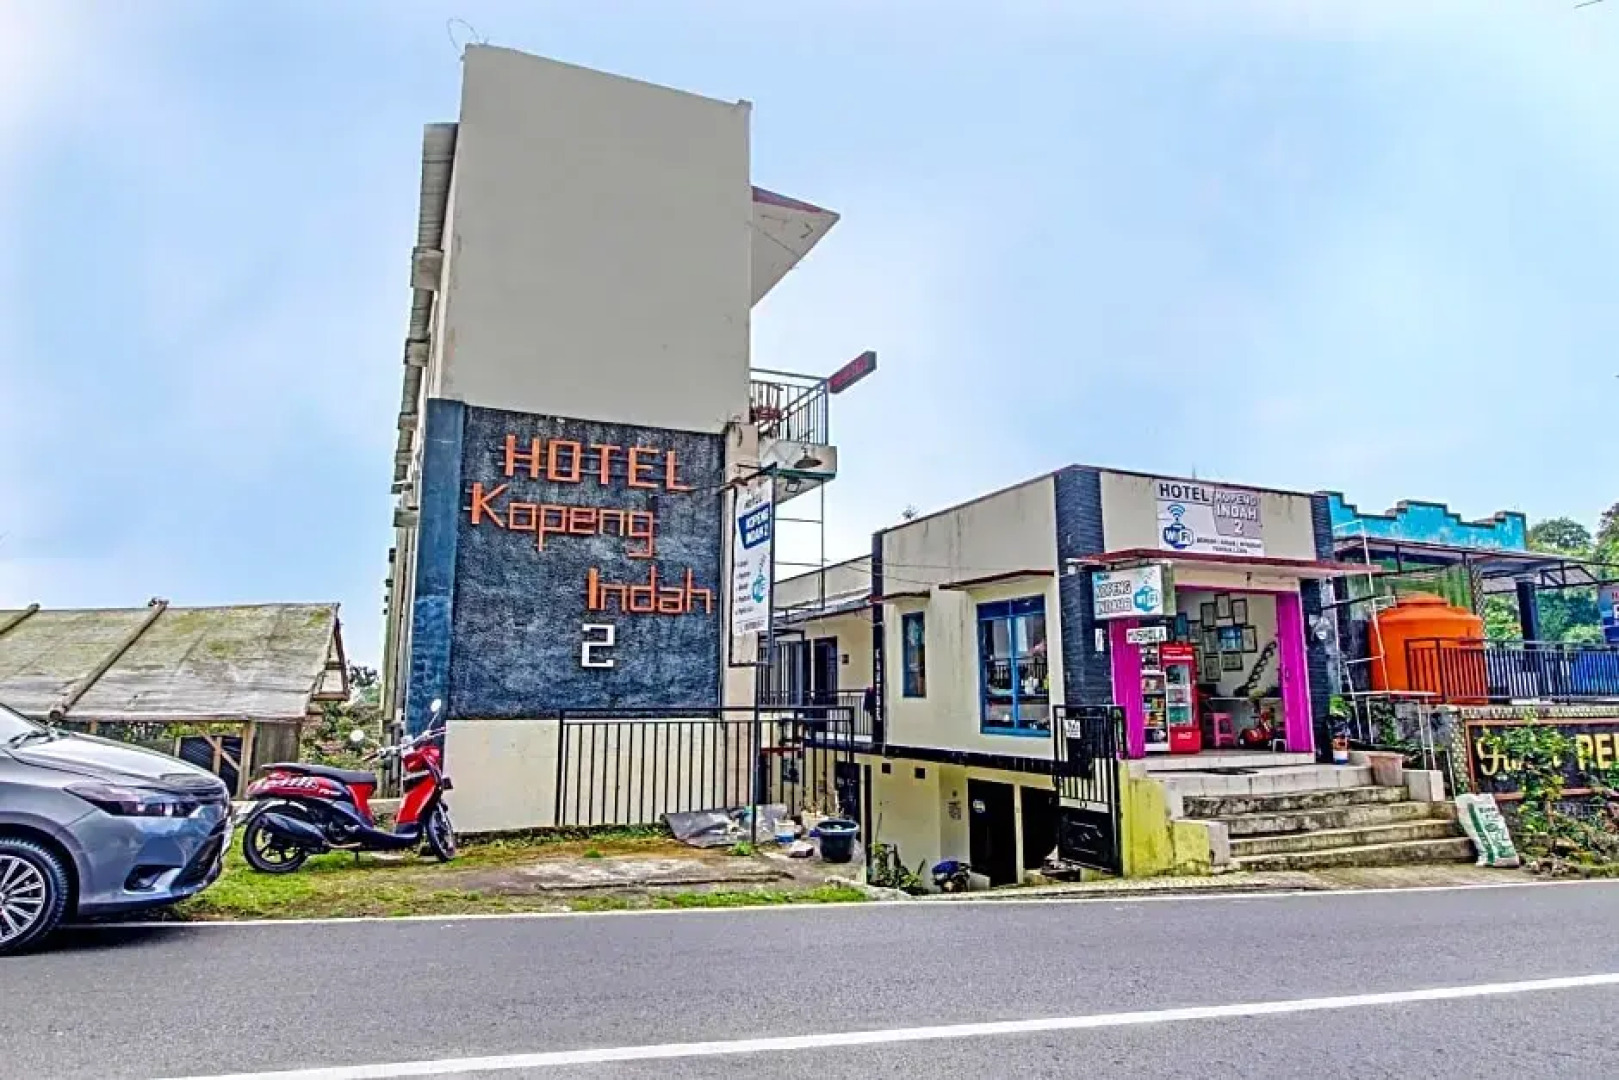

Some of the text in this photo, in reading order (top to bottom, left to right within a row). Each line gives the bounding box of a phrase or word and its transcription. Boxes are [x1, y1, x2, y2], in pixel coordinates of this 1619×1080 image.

[505, 434, 693, 492] HOTEL
[1159, 483, 1210, 502] HOTEL
[1216, 490, 1259, 507] KOPENG
[1216, 503, 1258, 523] INDAH
[1234, 519, 1244, 536] 2
[587, 565, 712, 615] Indah
[581, 623, 615, 668] 2
